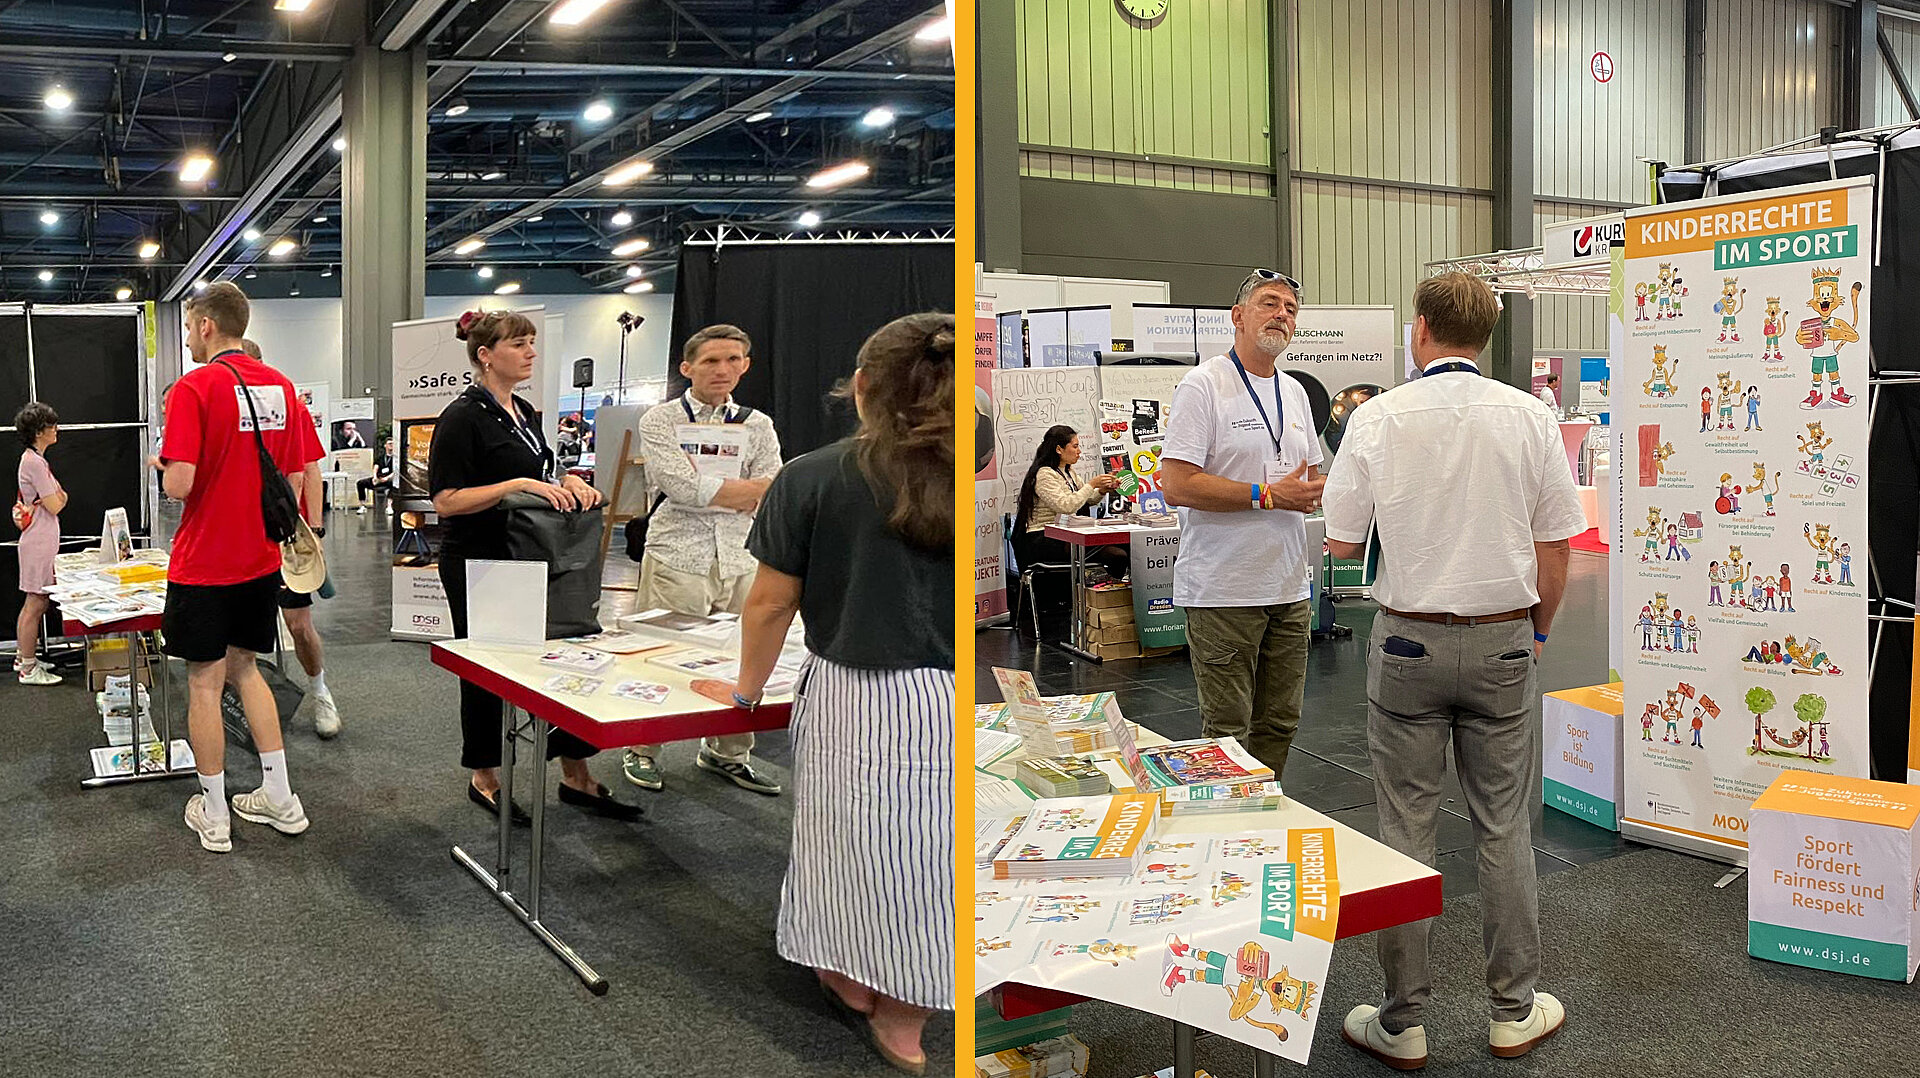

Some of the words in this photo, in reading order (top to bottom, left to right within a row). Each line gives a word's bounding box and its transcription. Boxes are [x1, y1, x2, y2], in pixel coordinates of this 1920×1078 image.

[1641, 200, 1833, 244] KINDERRECHTE
[1721, 242, 1750, 265] IM
[1758, 230, 1850, 262] SPORT
[975, 360, 993, 368] FINDEN
[1286, 352, 1334, 363] Gefangen
[1337, 353, 1349, 361] im
[1352, 353, 1382, 361] Netz?!
[1001, 370, 1066, 400] HUNGER
[1102, 422, 1128, 433] STARS
[981, 496, 998, 510] vor
[1146, 536, 1180, 546] Präve
[1147, 556, 1168, 569] bei
[1567, 724, 1589, 740] Sport
[1573, 740, 1583, 753] ist
[1563, 751, 1594, 773] Bildung
[1798, 790, 1852, 799] Jugend
[1827, 788, 1884, 799] Zukunft
[1556, 794, 1598, 816] www.dsj.de
[1847, 800, 1887, 808] Sport
[1068, 838, 1096, 850] IM
[1804, 836, 1853, 856] Sport
[1268, 865, 1291, 878] IM
[1797, 853, 1861, 876] fördert
[1302, 832, 1327, 921] KINDERREHTE
[1774, 870, 1845, 894] Fairness
[1852, 885, 1884, 900] und
[1792, 892, 1864, 916] Respekt
[1778, 942, 1870, 966] www.dsj.de
